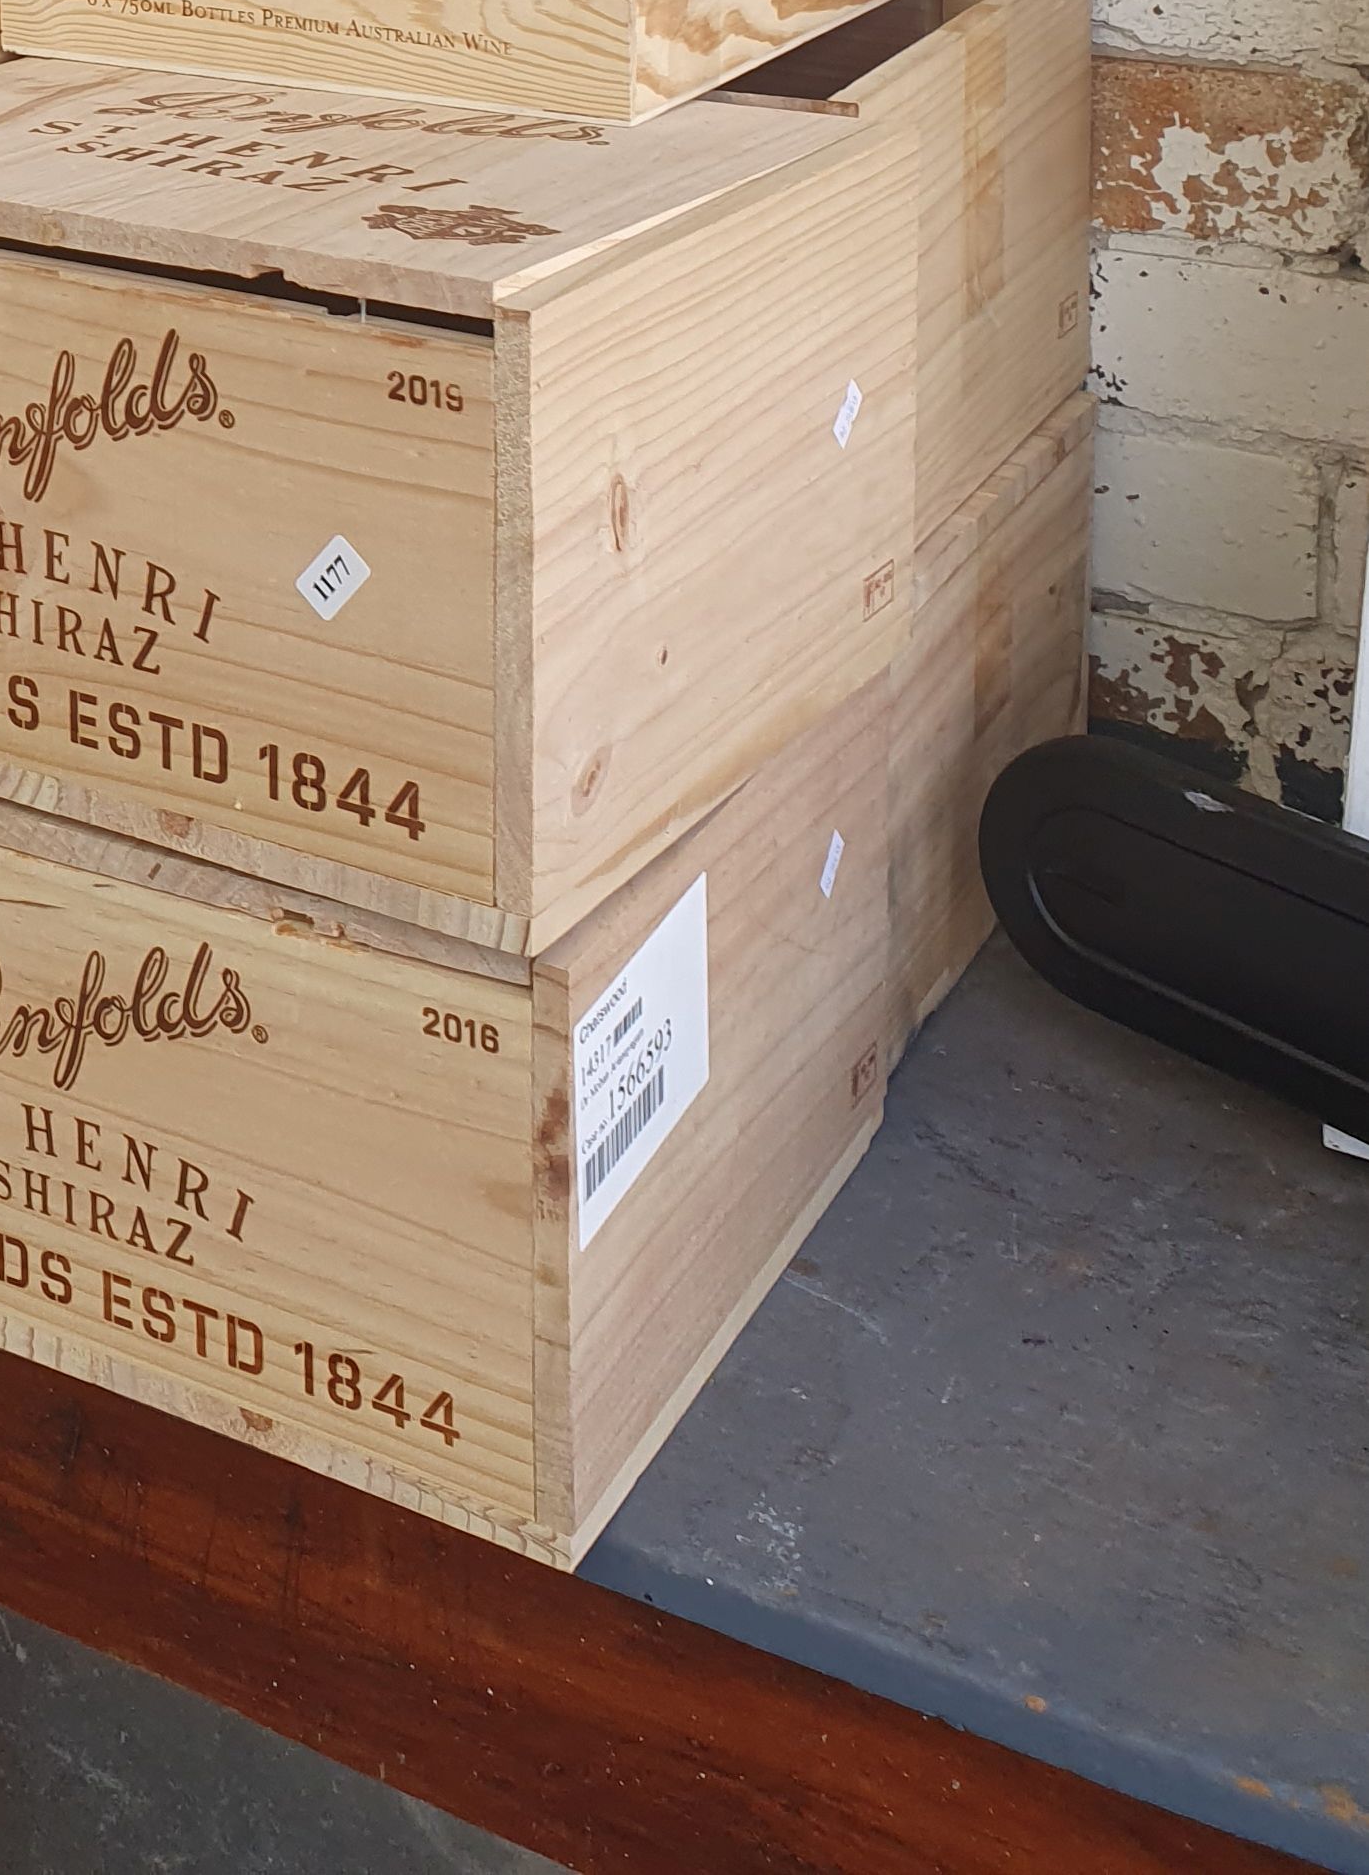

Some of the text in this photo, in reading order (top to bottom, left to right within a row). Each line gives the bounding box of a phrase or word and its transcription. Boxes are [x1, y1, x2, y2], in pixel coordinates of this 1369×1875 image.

[56, 139, 351, 193] SHIRAZ
[148, 130, 468, 193] HENRI
[312, 554, 351, 602] 1177
[68, 689, 230, 786] ESTD
[257, 741, 428, 843] 1844
[422, 1007, 501, 1054] 2016
[609, 1017, 672, 1122] 1566593
[21, 1101, 255, 1243] HENRI
[101, 1270, 265, 1376] ESTD
[294, 1341, 462, 1448] 1844
